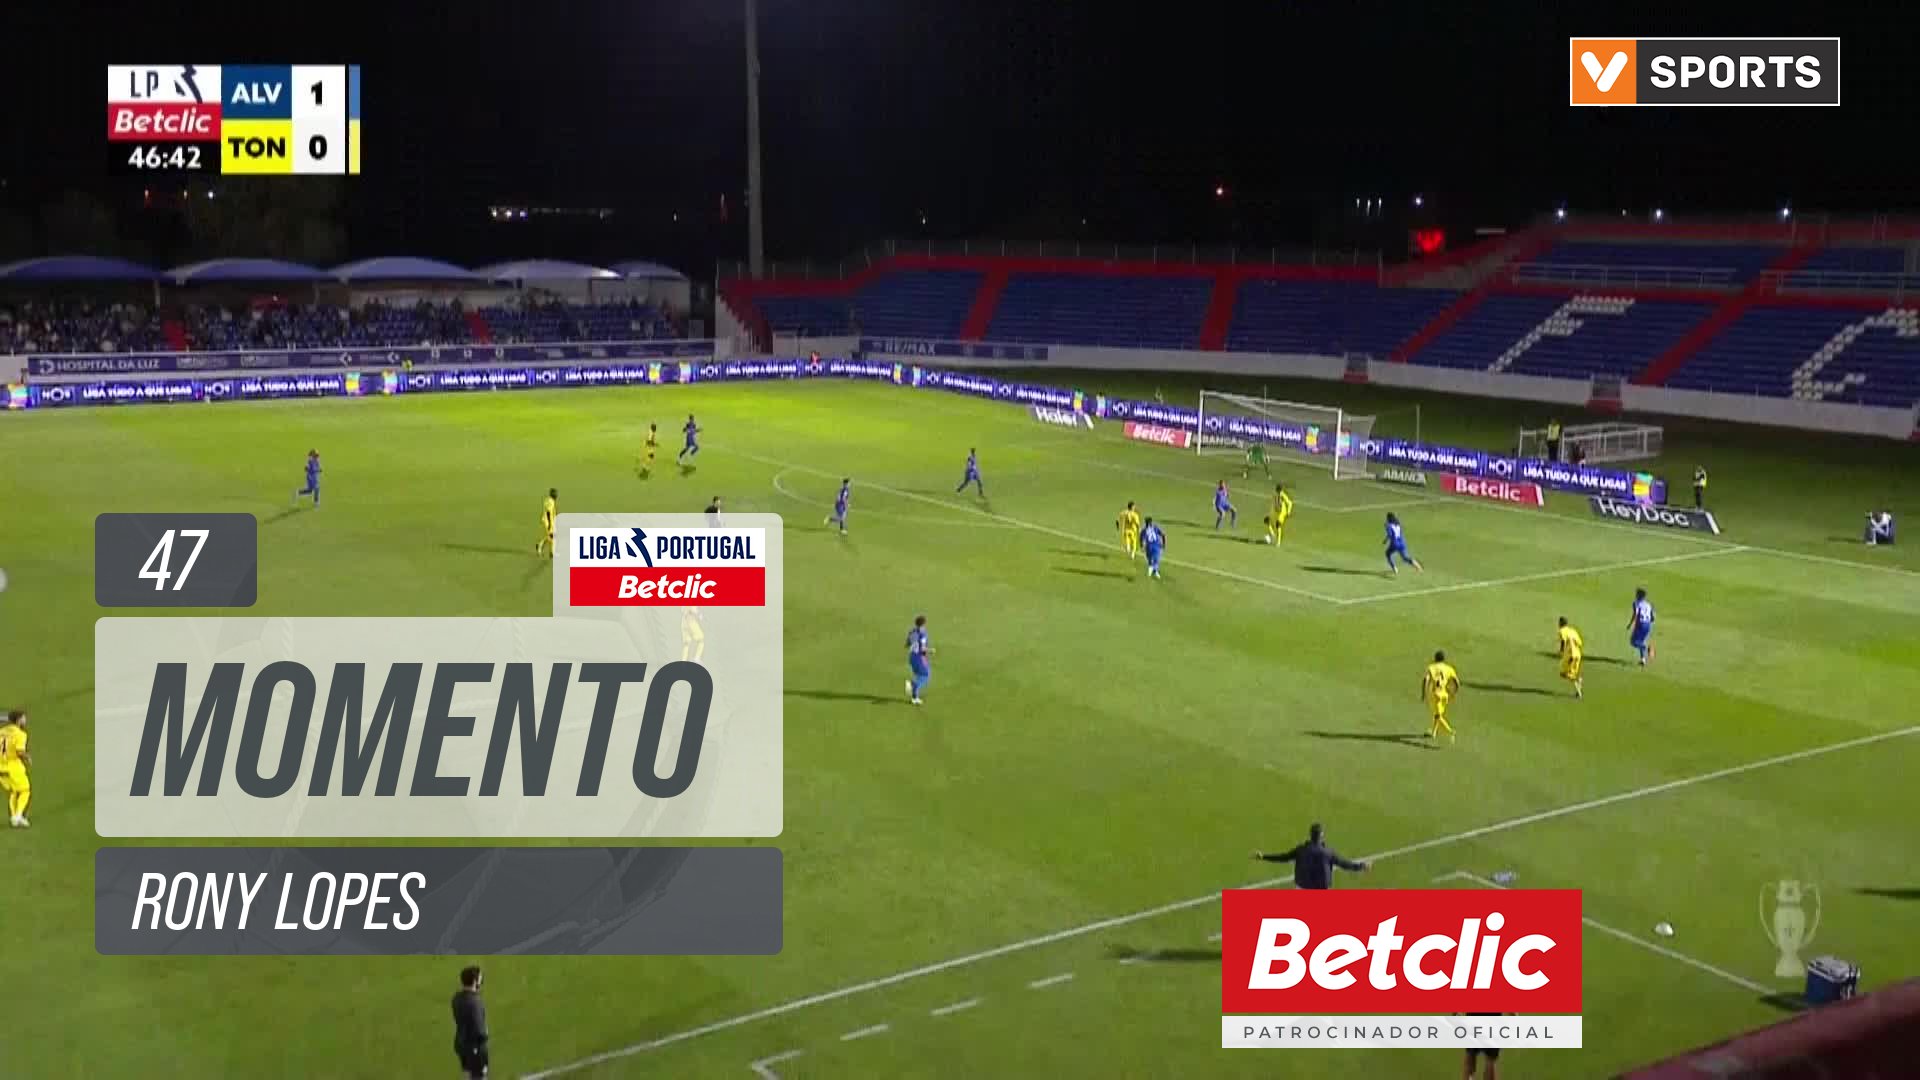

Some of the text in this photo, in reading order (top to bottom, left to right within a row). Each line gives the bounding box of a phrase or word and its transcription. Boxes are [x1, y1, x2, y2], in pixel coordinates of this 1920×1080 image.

[57, 359, 160, 370] HOSPITAL DA LUZ
[1132, 422, 1177, 445] Betclic
[1455, 474, 1521, 502] Betclic
[1523, 466, 1543, 478] LIGA
[1544, 469, 1570, 481] TUDO
[1571, 473, 1578, 485] A
[1579, 475, 1599, 488] QUE
[1598, 497, 1691, 528] HeyDoc
